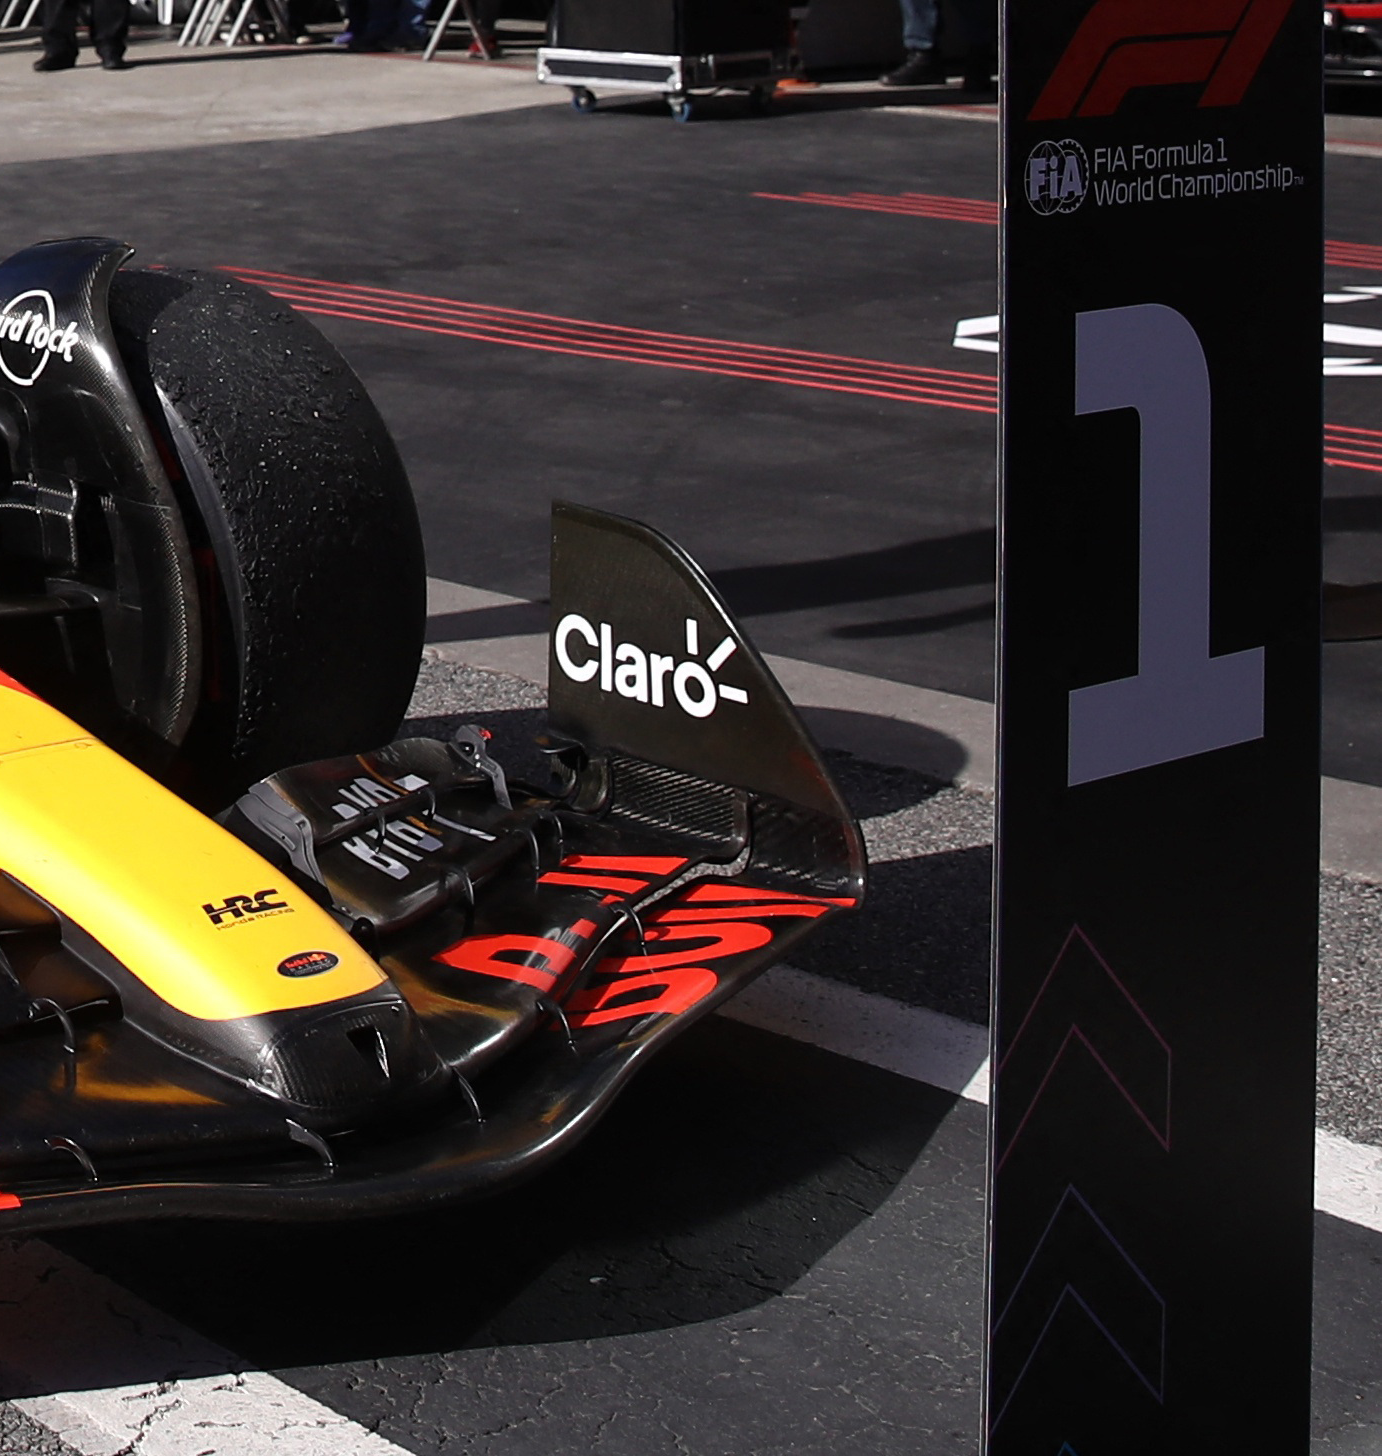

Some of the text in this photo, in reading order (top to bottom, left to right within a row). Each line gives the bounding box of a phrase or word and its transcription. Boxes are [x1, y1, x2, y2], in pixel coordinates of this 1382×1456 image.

[1027, 137, 1229, 202] FIA FIA Formula 1
[1093, 176, 1154, 206] World
[1067, 302, 1265, 787] 1
[554, 613, 730, 719] Claro
[201, 888, 289, 925] HRC
